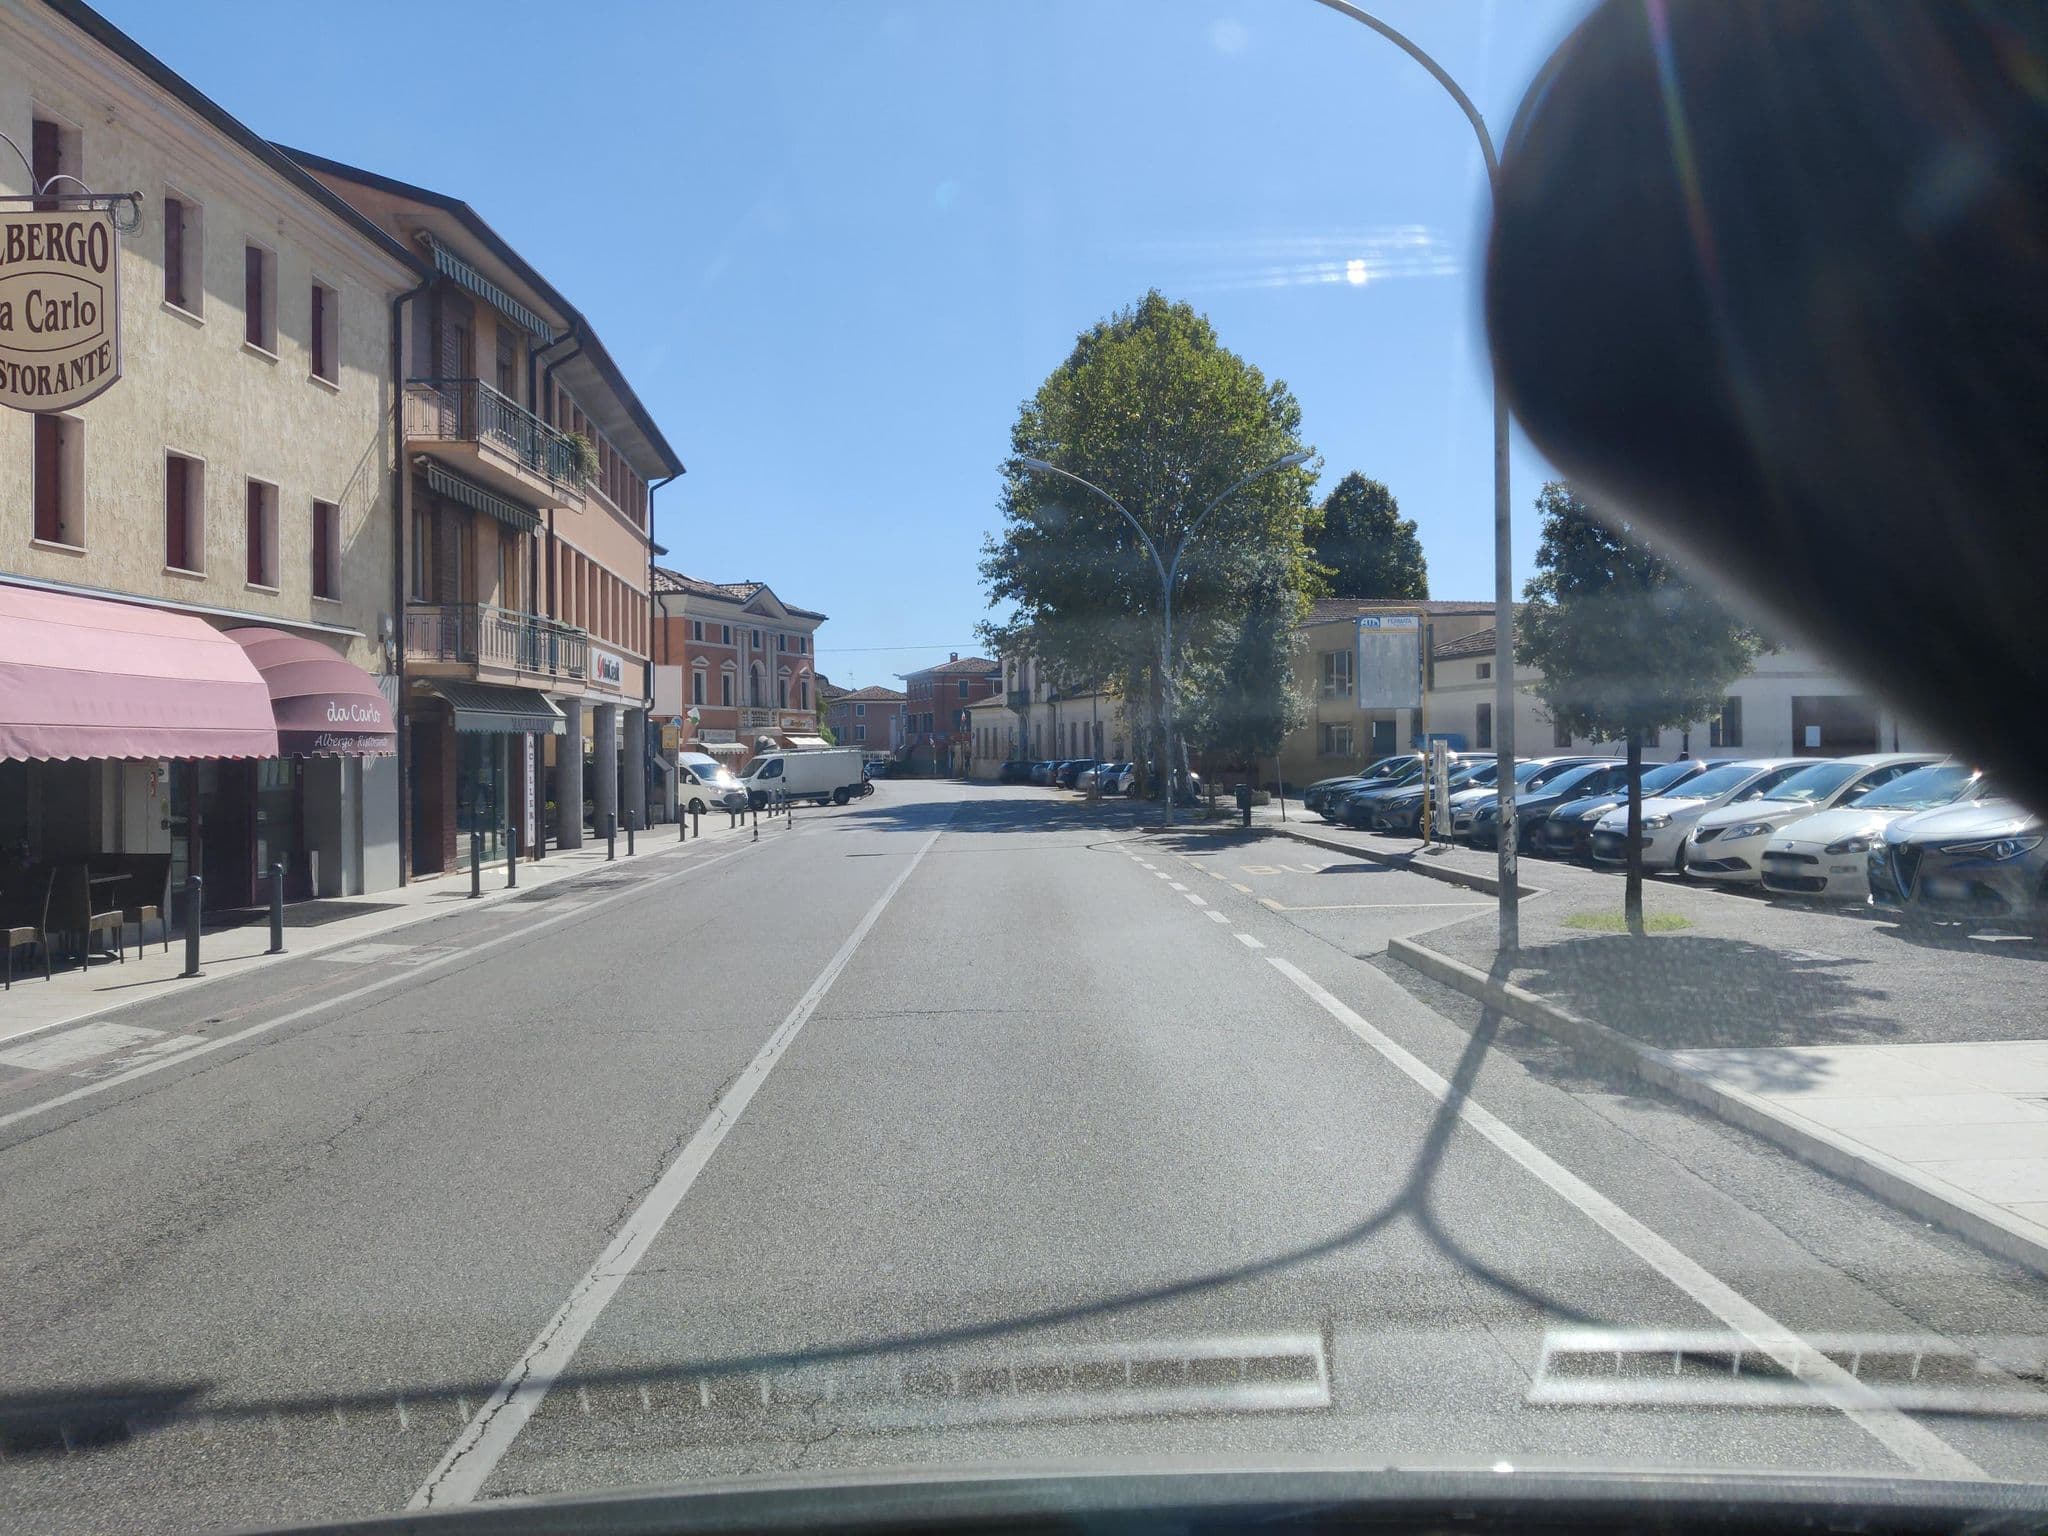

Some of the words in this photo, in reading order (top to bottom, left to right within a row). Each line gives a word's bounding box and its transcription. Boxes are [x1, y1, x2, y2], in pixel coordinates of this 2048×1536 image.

[25, 288, 97, 334] Carlo
[327, 701, 350, 722] da
[351, 704, 381, 723] Carlo
[315, 733, 353, 751] Albergo
[357, 735, 388, 748] Risto
[1240, 863, 1333, 875] BU
